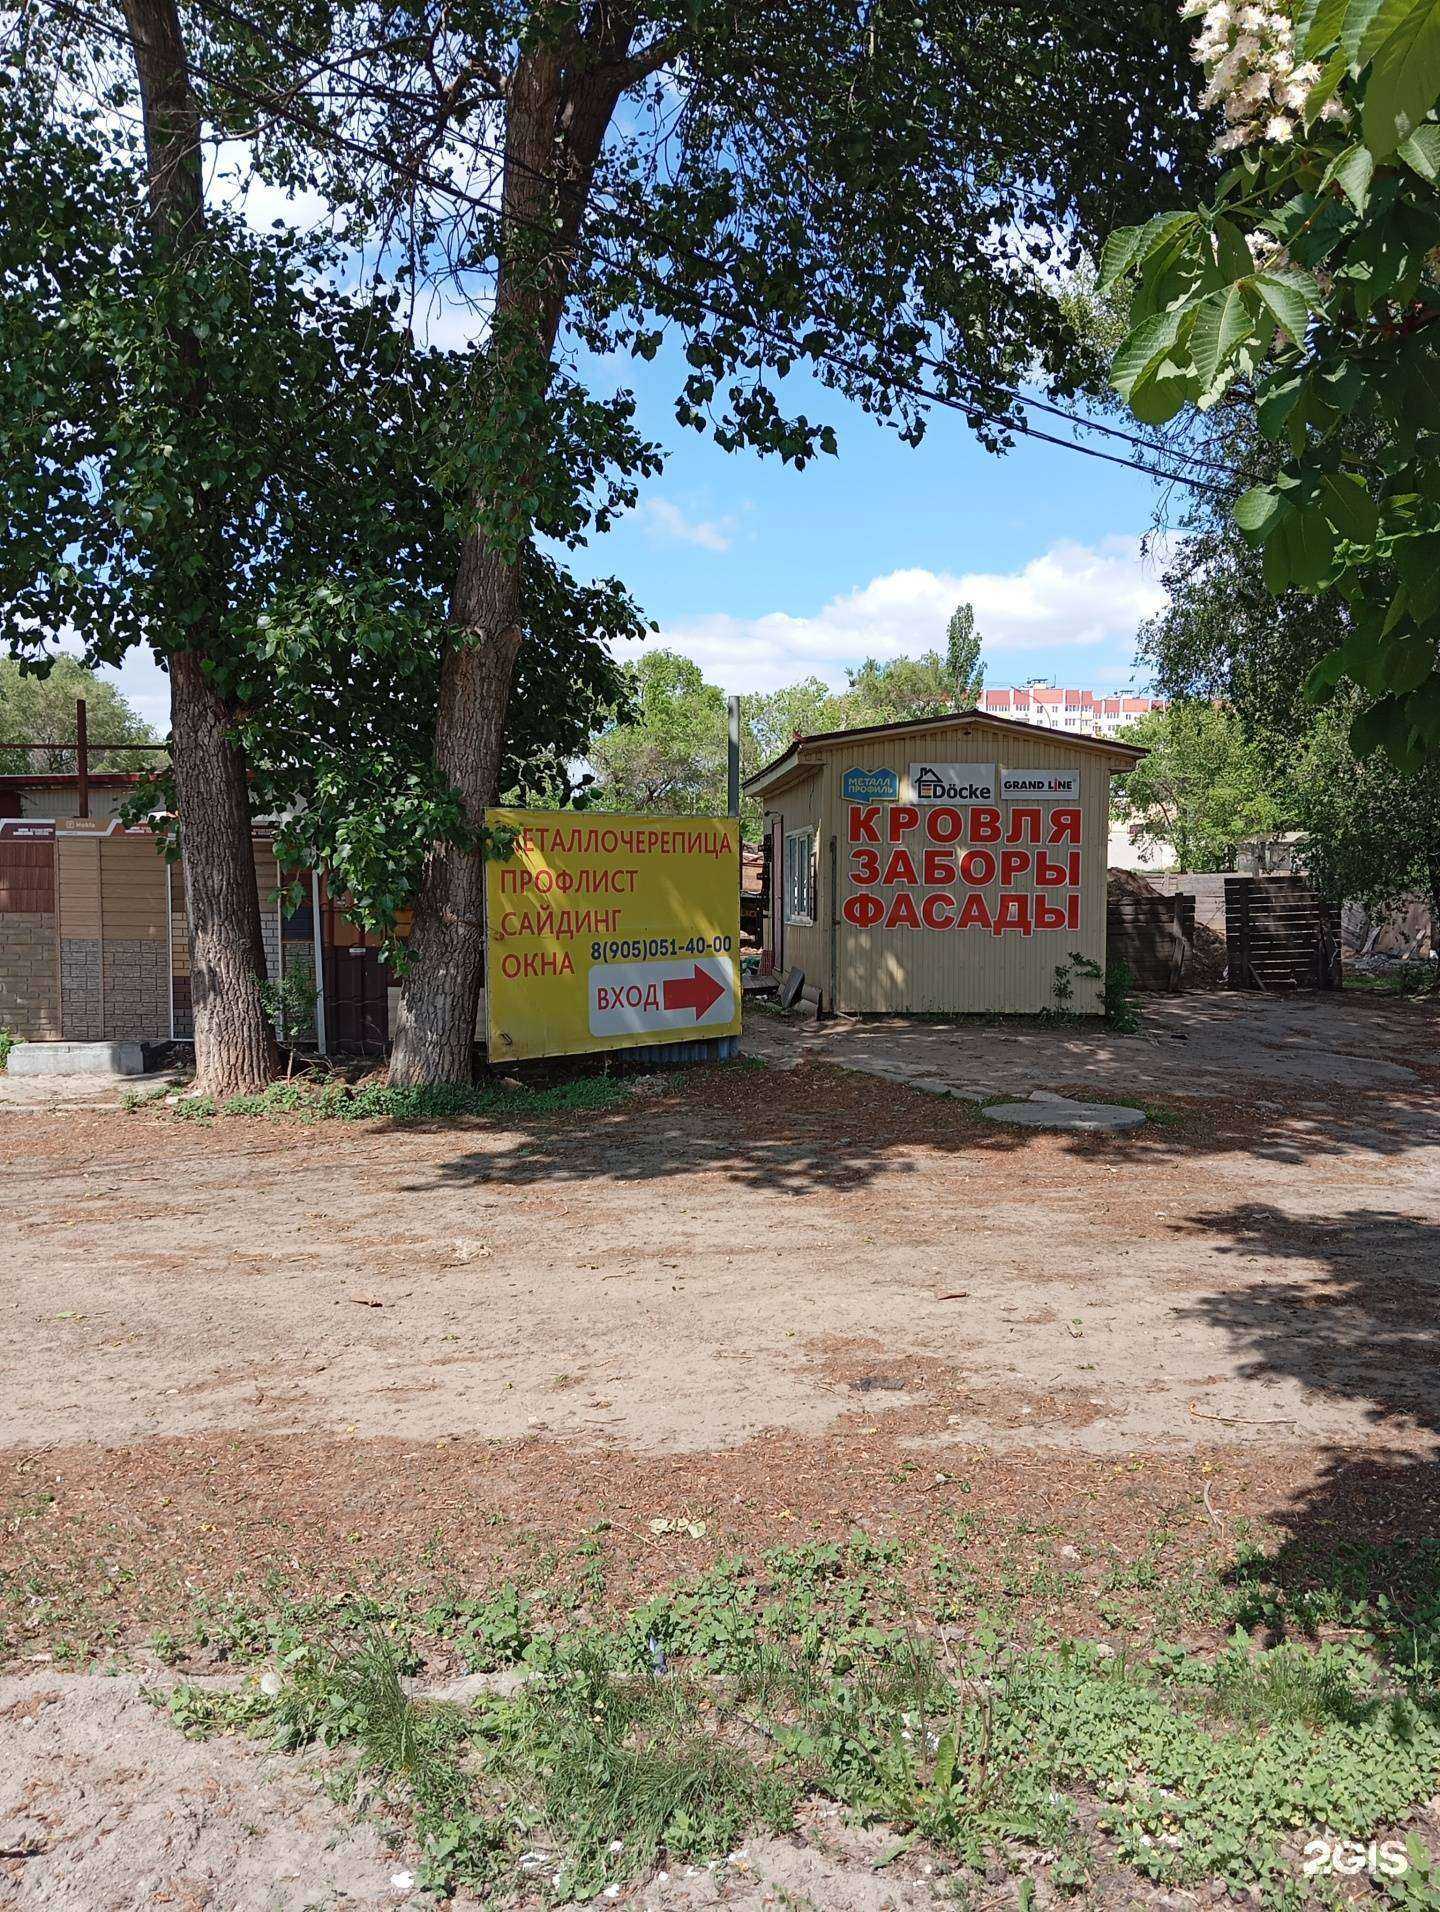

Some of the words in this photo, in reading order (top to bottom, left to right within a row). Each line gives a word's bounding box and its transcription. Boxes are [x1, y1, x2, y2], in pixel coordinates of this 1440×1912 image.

[847, 777, 890, 786] МЕТАЛЛ
[847, 785, 894, 794] ПРОФИЛЬ
[932, 783, 991, 800] Döcke
[1003, 780, 1045, 790] GRAND
[848, 805, 1083, 845] КРОВЛЯ
[508, 827, 732, 859] ЕТАЛЛОЧЕРЕПИЦА
[500, 869, 639, 895] ПРОФЛИСТ
[849, 848, 1081, 888] ЗАБОРЫ
[501, 903, 622, 940] САЙДИНГ
[842, 891, 1081, 937] ФАСАДЫ
[591, 935, 732, 962] 8(905)051-40-00
[501, 951, 576, 979] ОКНА
[596, 983, 660, 1012] ВХОД
